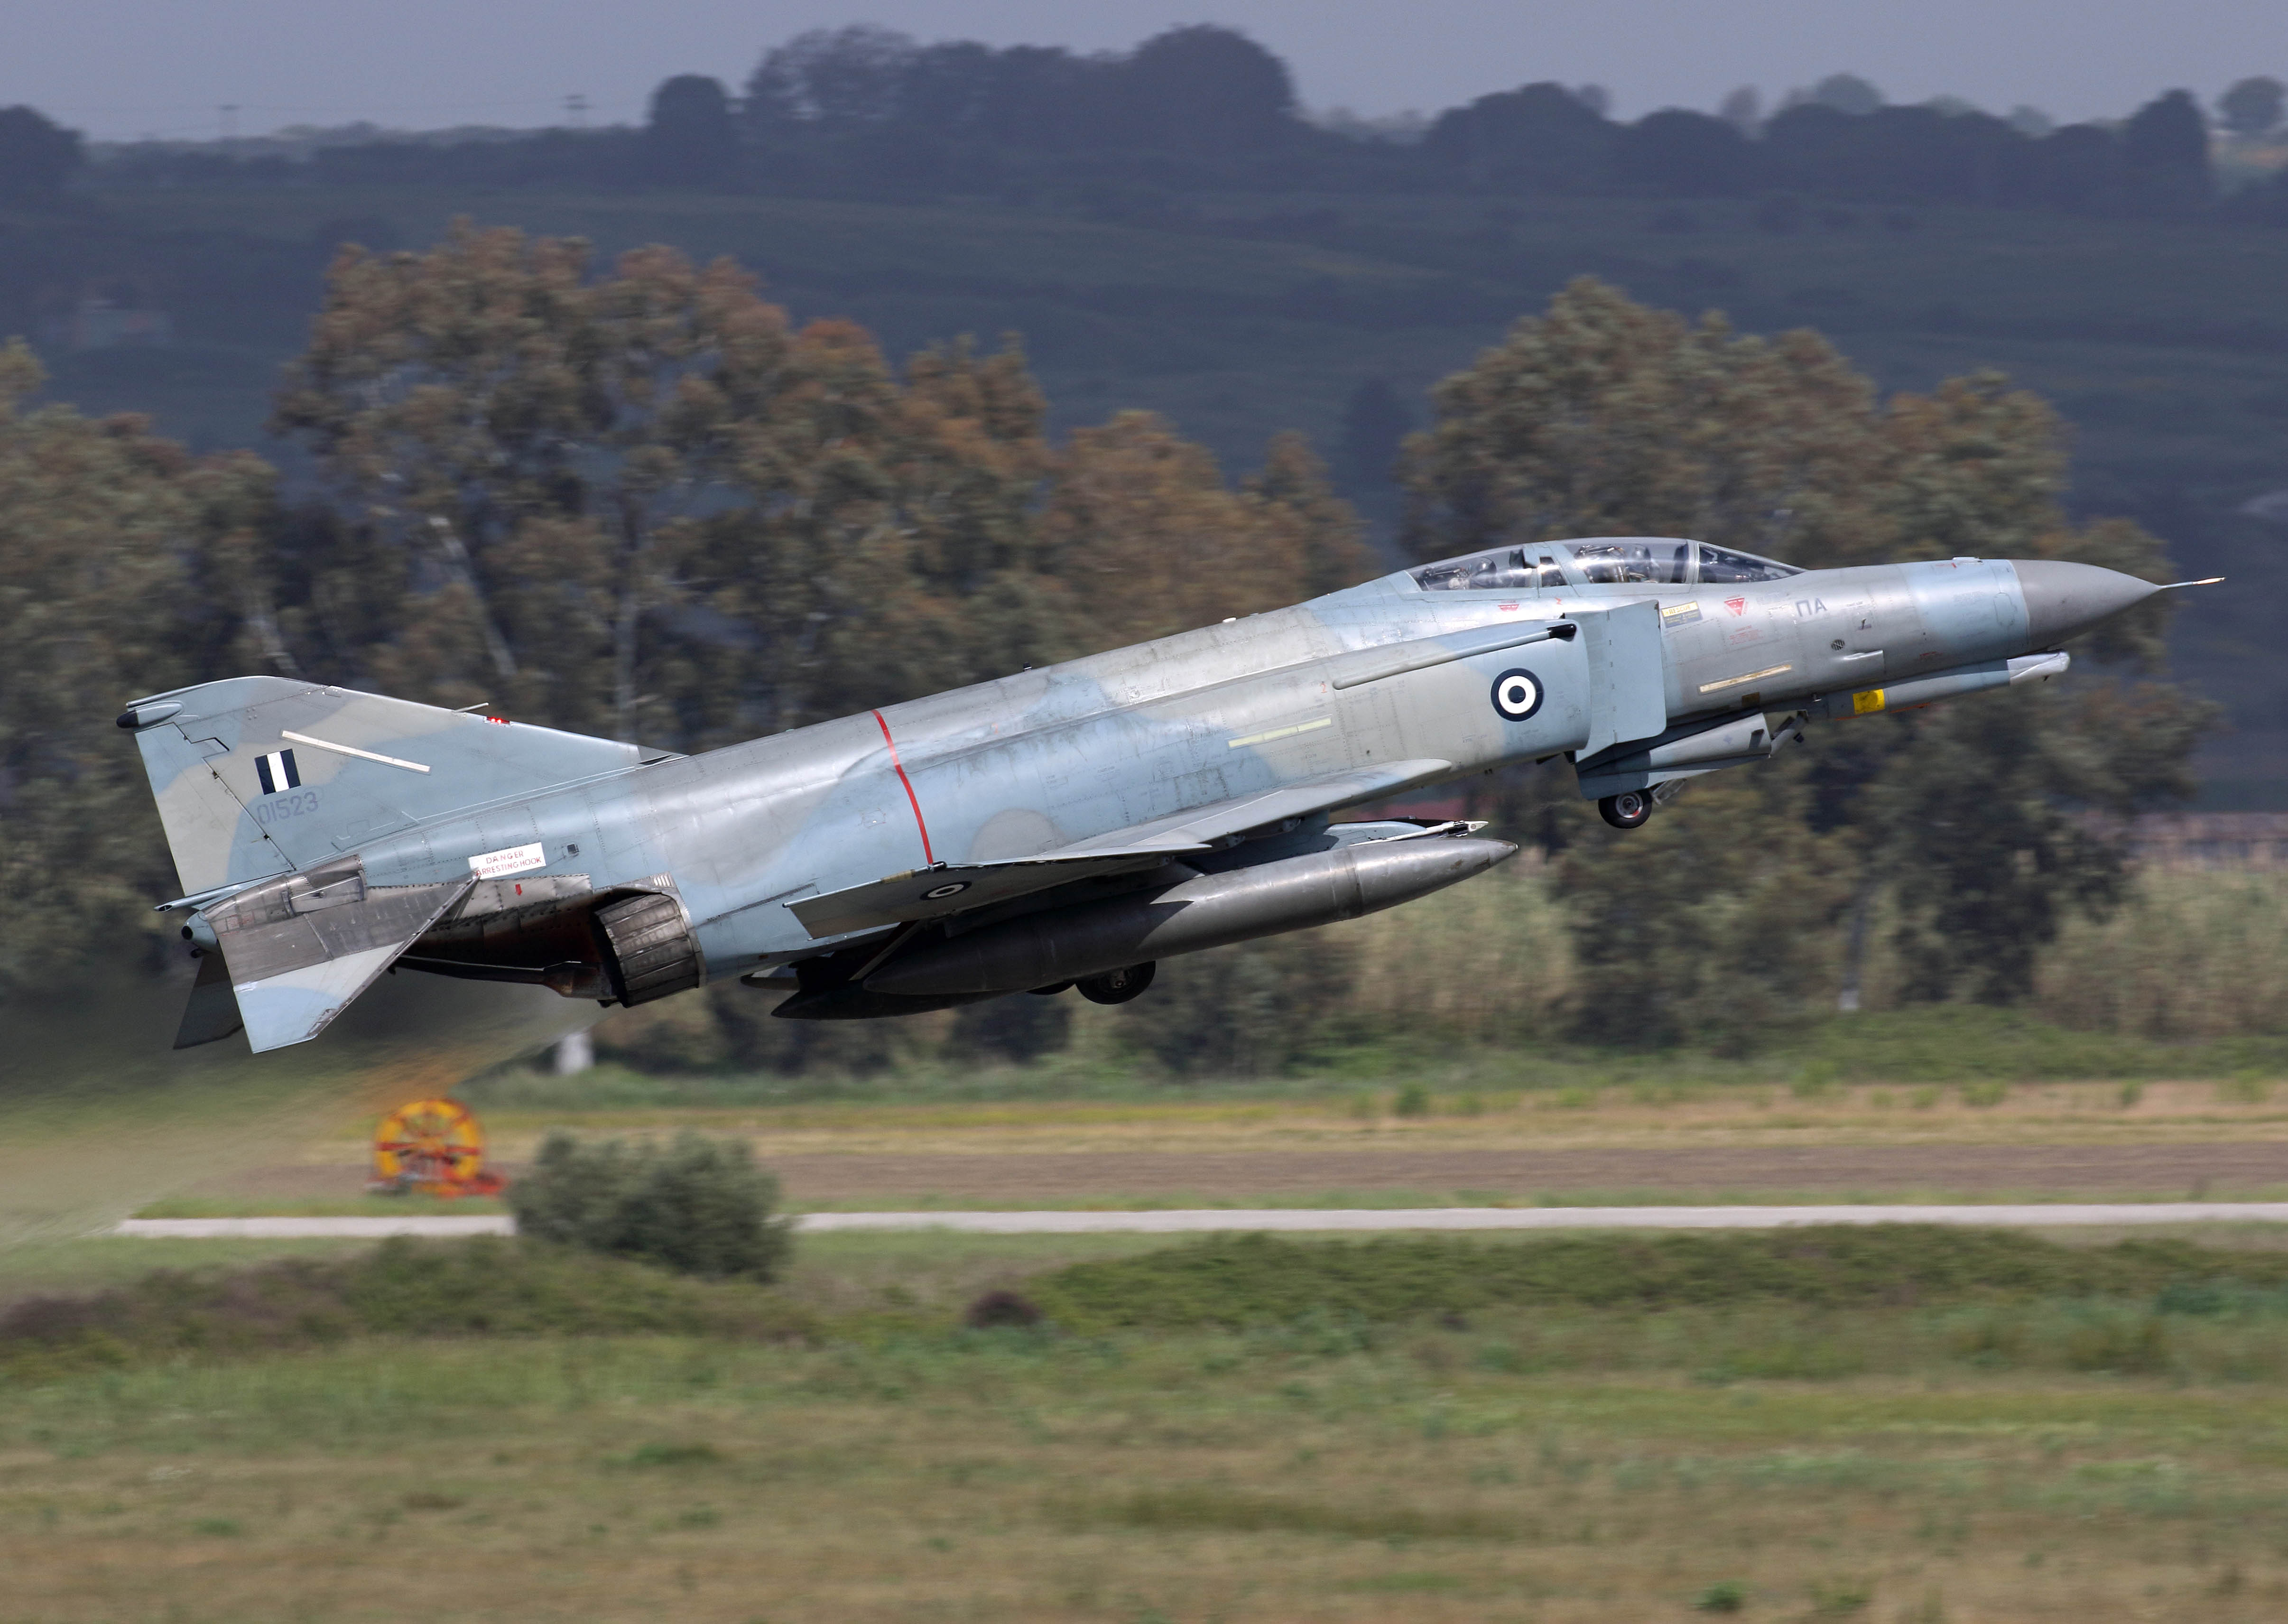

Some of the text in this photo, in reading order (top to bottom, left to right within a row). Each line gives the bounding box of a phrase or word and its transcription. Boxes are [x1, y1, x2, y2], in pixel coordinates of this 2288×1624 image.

[257, 791, 319, 824] 01523
[476, 857, 542, 876] ARRESTING HOOK
[486, 850, 524, 864] DANGER
